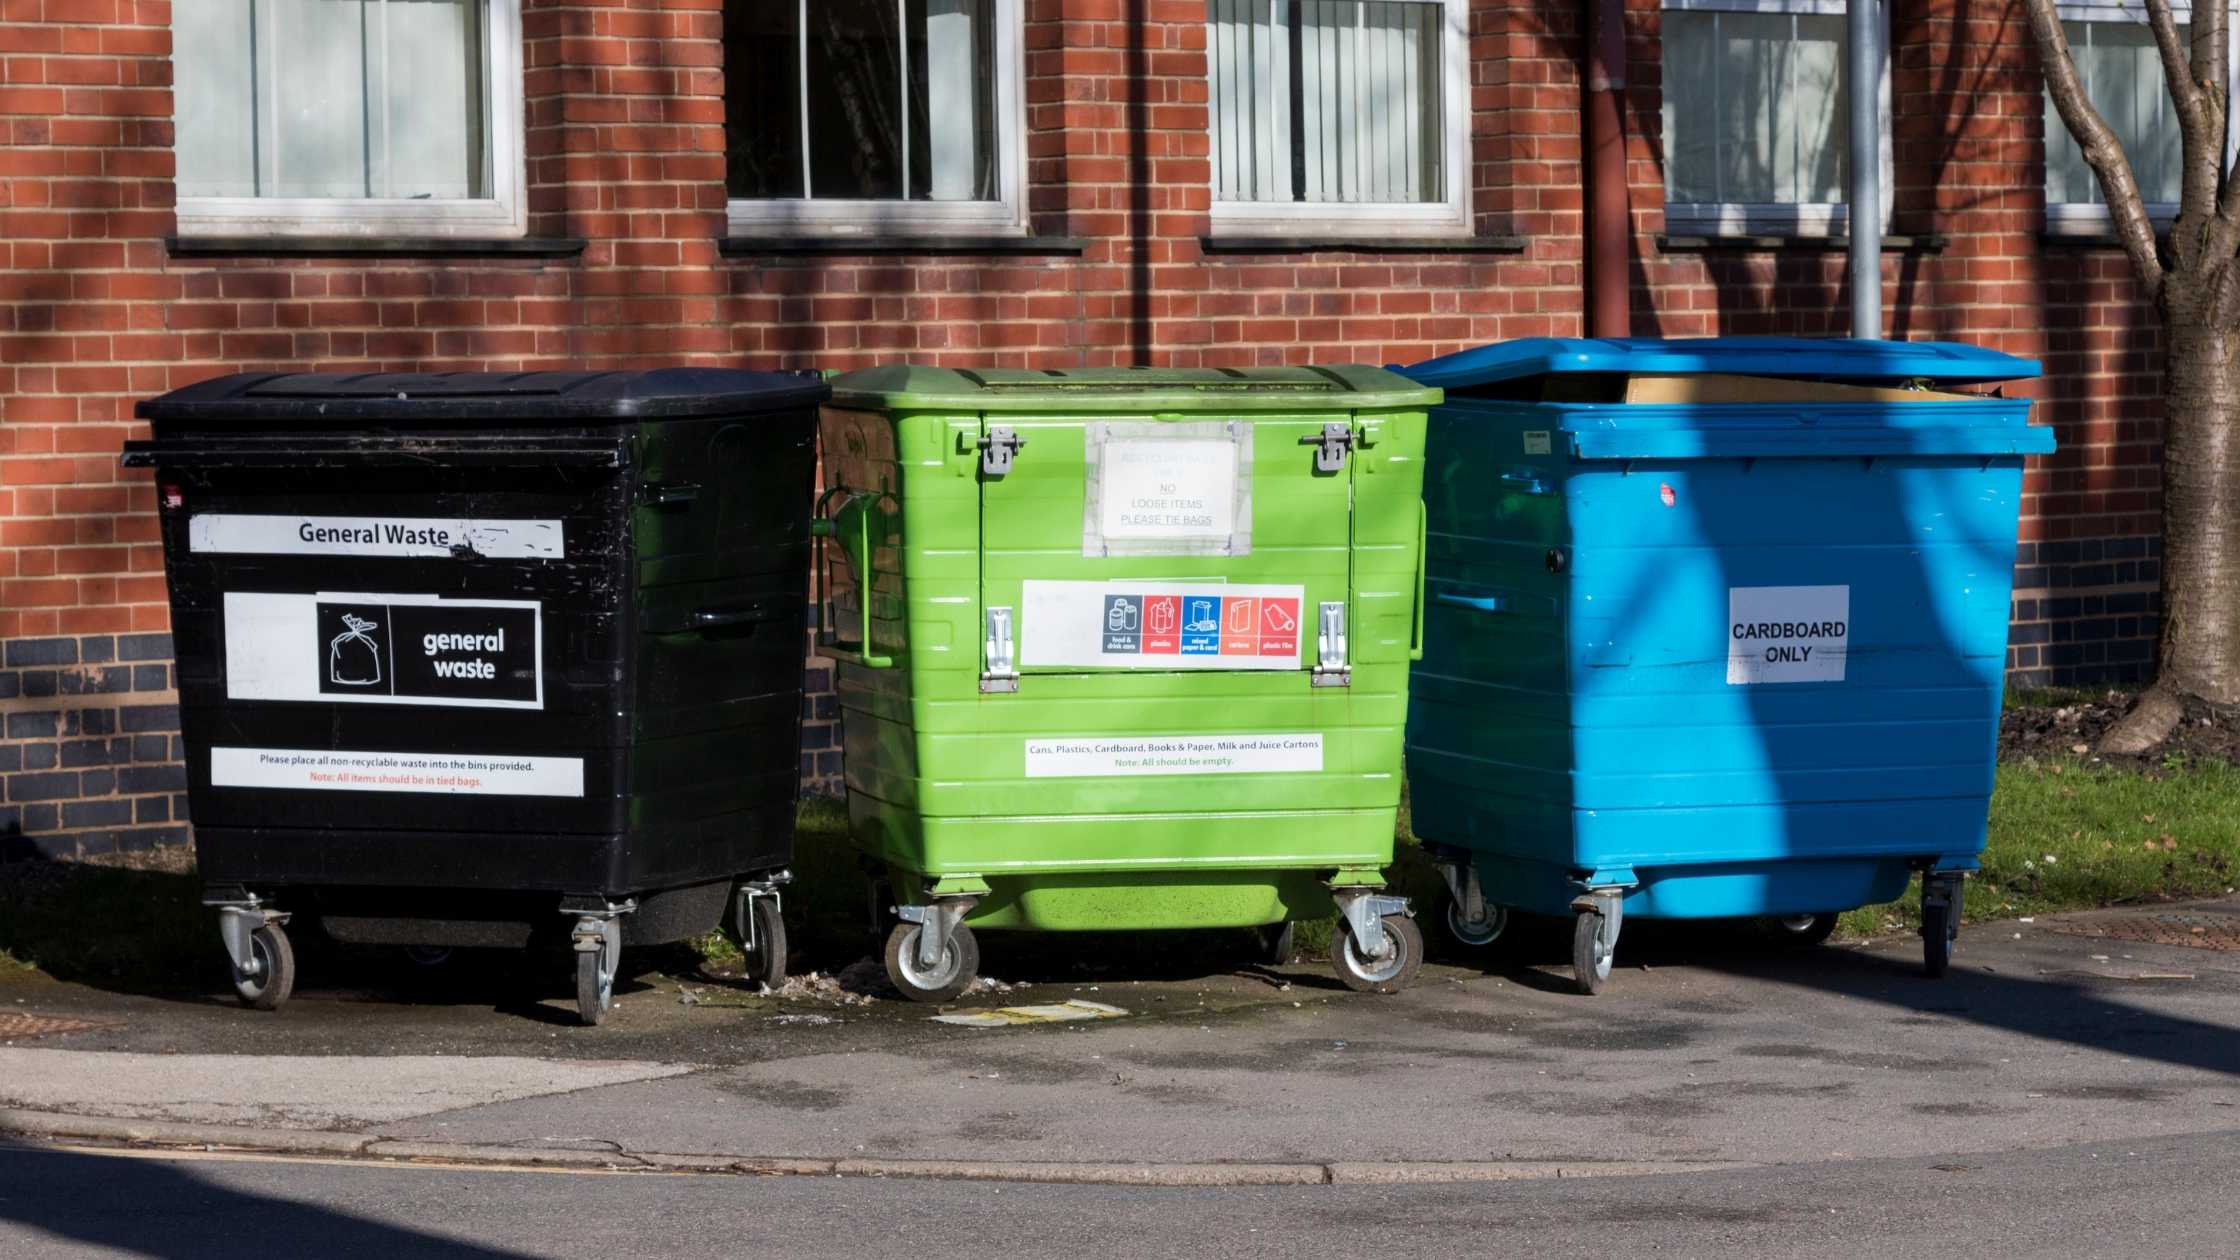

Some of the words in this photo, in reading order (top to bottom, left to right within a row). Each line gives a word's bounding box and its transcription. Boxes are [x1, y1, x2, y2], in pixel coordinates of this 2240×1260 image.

[1160, 484, 1176, 493] NO
[1131, 499, 1167, 509] LOOSE
[1170, 499, 1202, 509] ITEMS
[1120, 514, 1161, 526] PLEASE
[1165, 514, 1180, 526] TIE
[1184, 514, 1213, 526] BAGS
[299, 522, 379, 544] General
[384, 524, 449, 545] Waste
[1732, 621, 1846, 640] CARDBOARD
[423, 628, 504, 656] general
[1765, 646, 1813, 663] ONLY
[433, 657, 496, 679] waste
[1095, 744, 1146, 753] Cardboard,
[1148, 743, 1176, 752] Books
[1179, 743, 1184, 751] &
[1218, 741, 1236, 750] Milk
[1239, 741, 1256, 750] and
[1259, 740, 1281, 750] Juice
[1283, 740, 1319, 750] Cartons
[260, 754, 288, 765] Please
[291, 754, 316, 766] place
[317, 755, 329, 765] all
[331, 757, 399, 768] non-recyclable
[400, 760, 427, 769] waste
[430, 760, 448, 769] into
[450, 760, 466, 770] the
[468, 760, 488, 770] bins
[489, 762, 535, 772] provided.
[1142, 758, 1155, 766] All
[1156, 758, 1187, 766] should
[1189, 758, 1200, 766] be
[310, 772, 336, 782] Note:
[337, 772, 350, 782] All
[352, 773, 376, 784] items
[379, 774, 410, 784] should
[412, 774, 424, 785] be
[426, 776, 435, 785] in
[437, 776, 456, 786] tied
